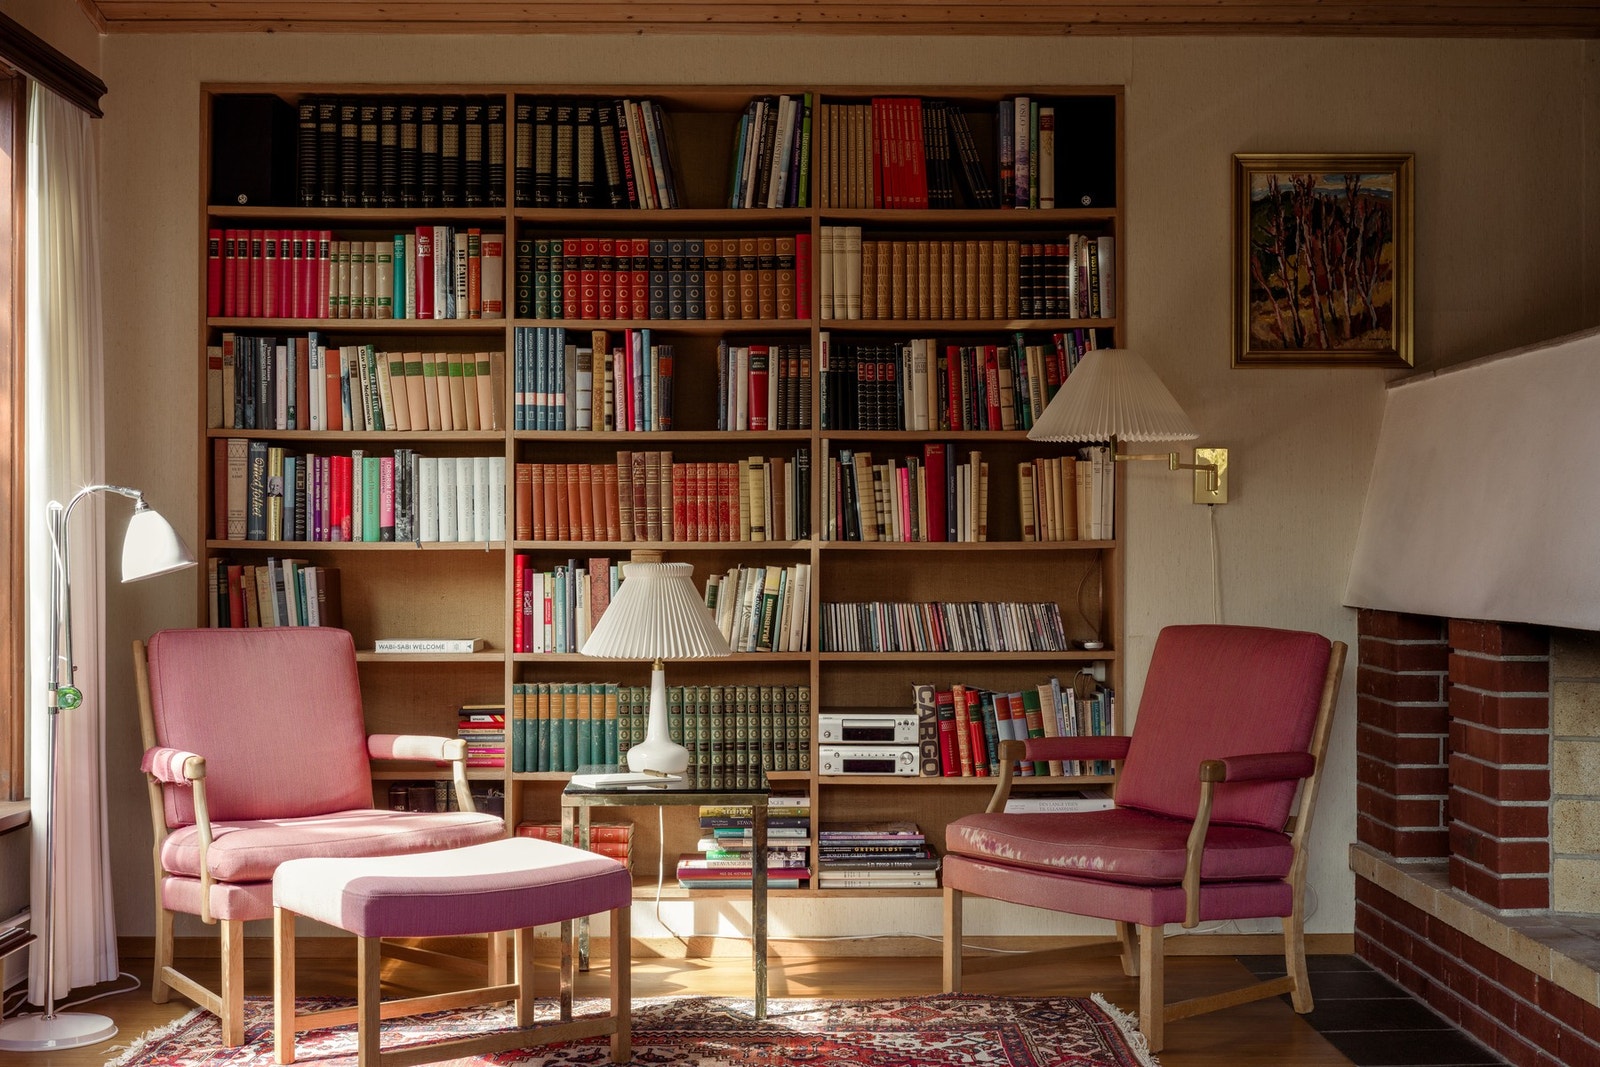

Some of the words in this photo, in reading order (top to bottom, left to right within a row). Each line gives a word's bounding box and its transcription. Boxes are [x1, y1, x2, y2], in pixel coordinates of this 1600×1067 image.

[620, 130, 631, 180] HISTORISKE
[626, 181, 636, 202] BYER
[801, 132, 809, 174] Uteromsboka
[250, 487, 264, 517] folket
[368, 485, 376, 515] Herrmann
[762, 598, 774, 643] monsarrat
[918, 686, 938, 776] CARGO
